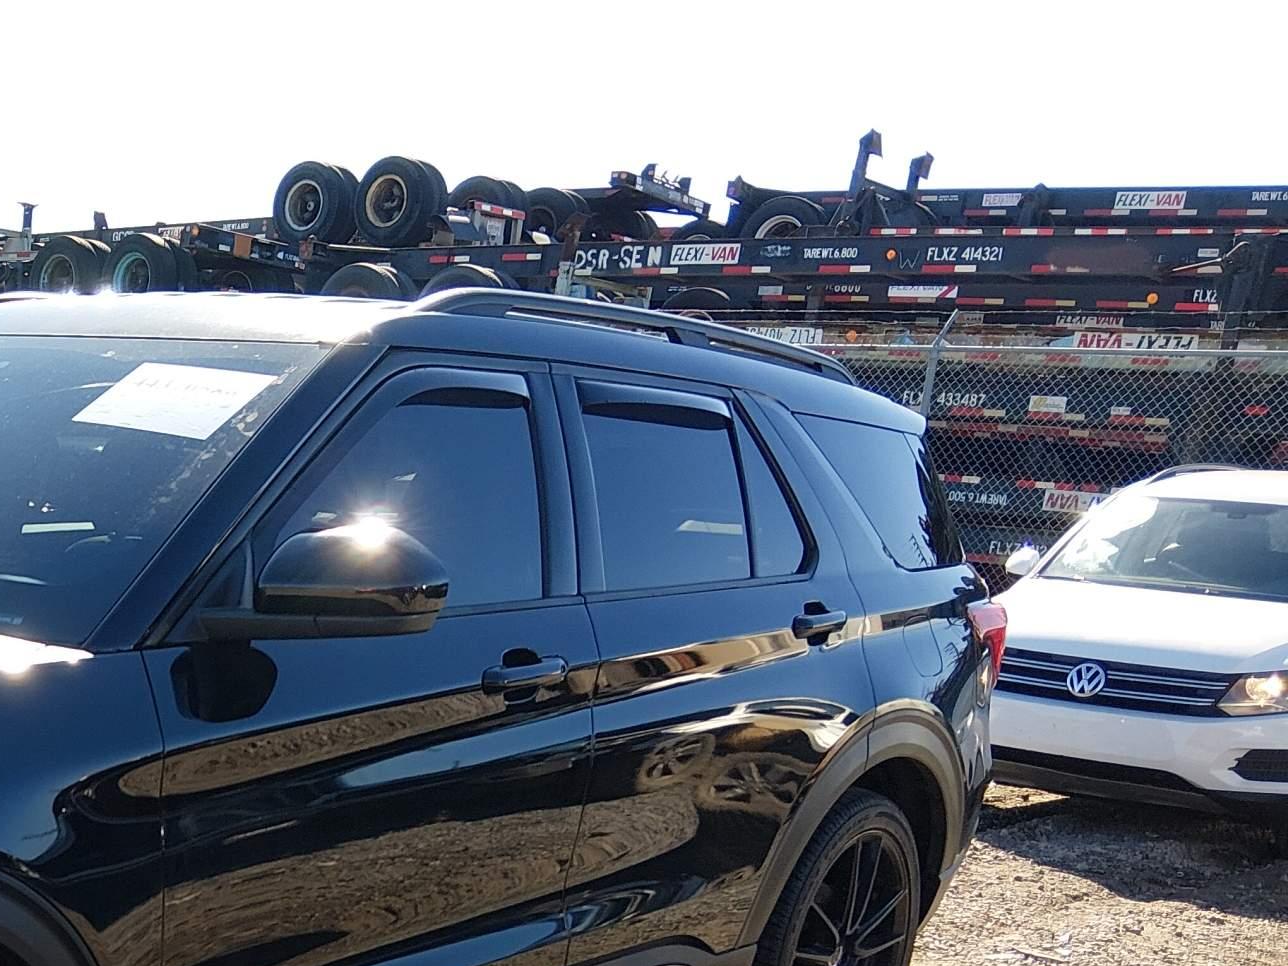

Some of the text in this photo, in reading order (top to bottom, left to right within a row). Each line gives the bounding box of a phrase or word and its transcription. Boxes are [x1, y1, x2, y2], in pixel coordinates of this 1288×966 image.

[1116, 193, 1184, 207] FLEXI-VAN
[673, 245, 739, 262] FLEXI-VAN
[926, 246, 1003, 261] FLXZ 414321
[936, 392, 987, 407] 433487
